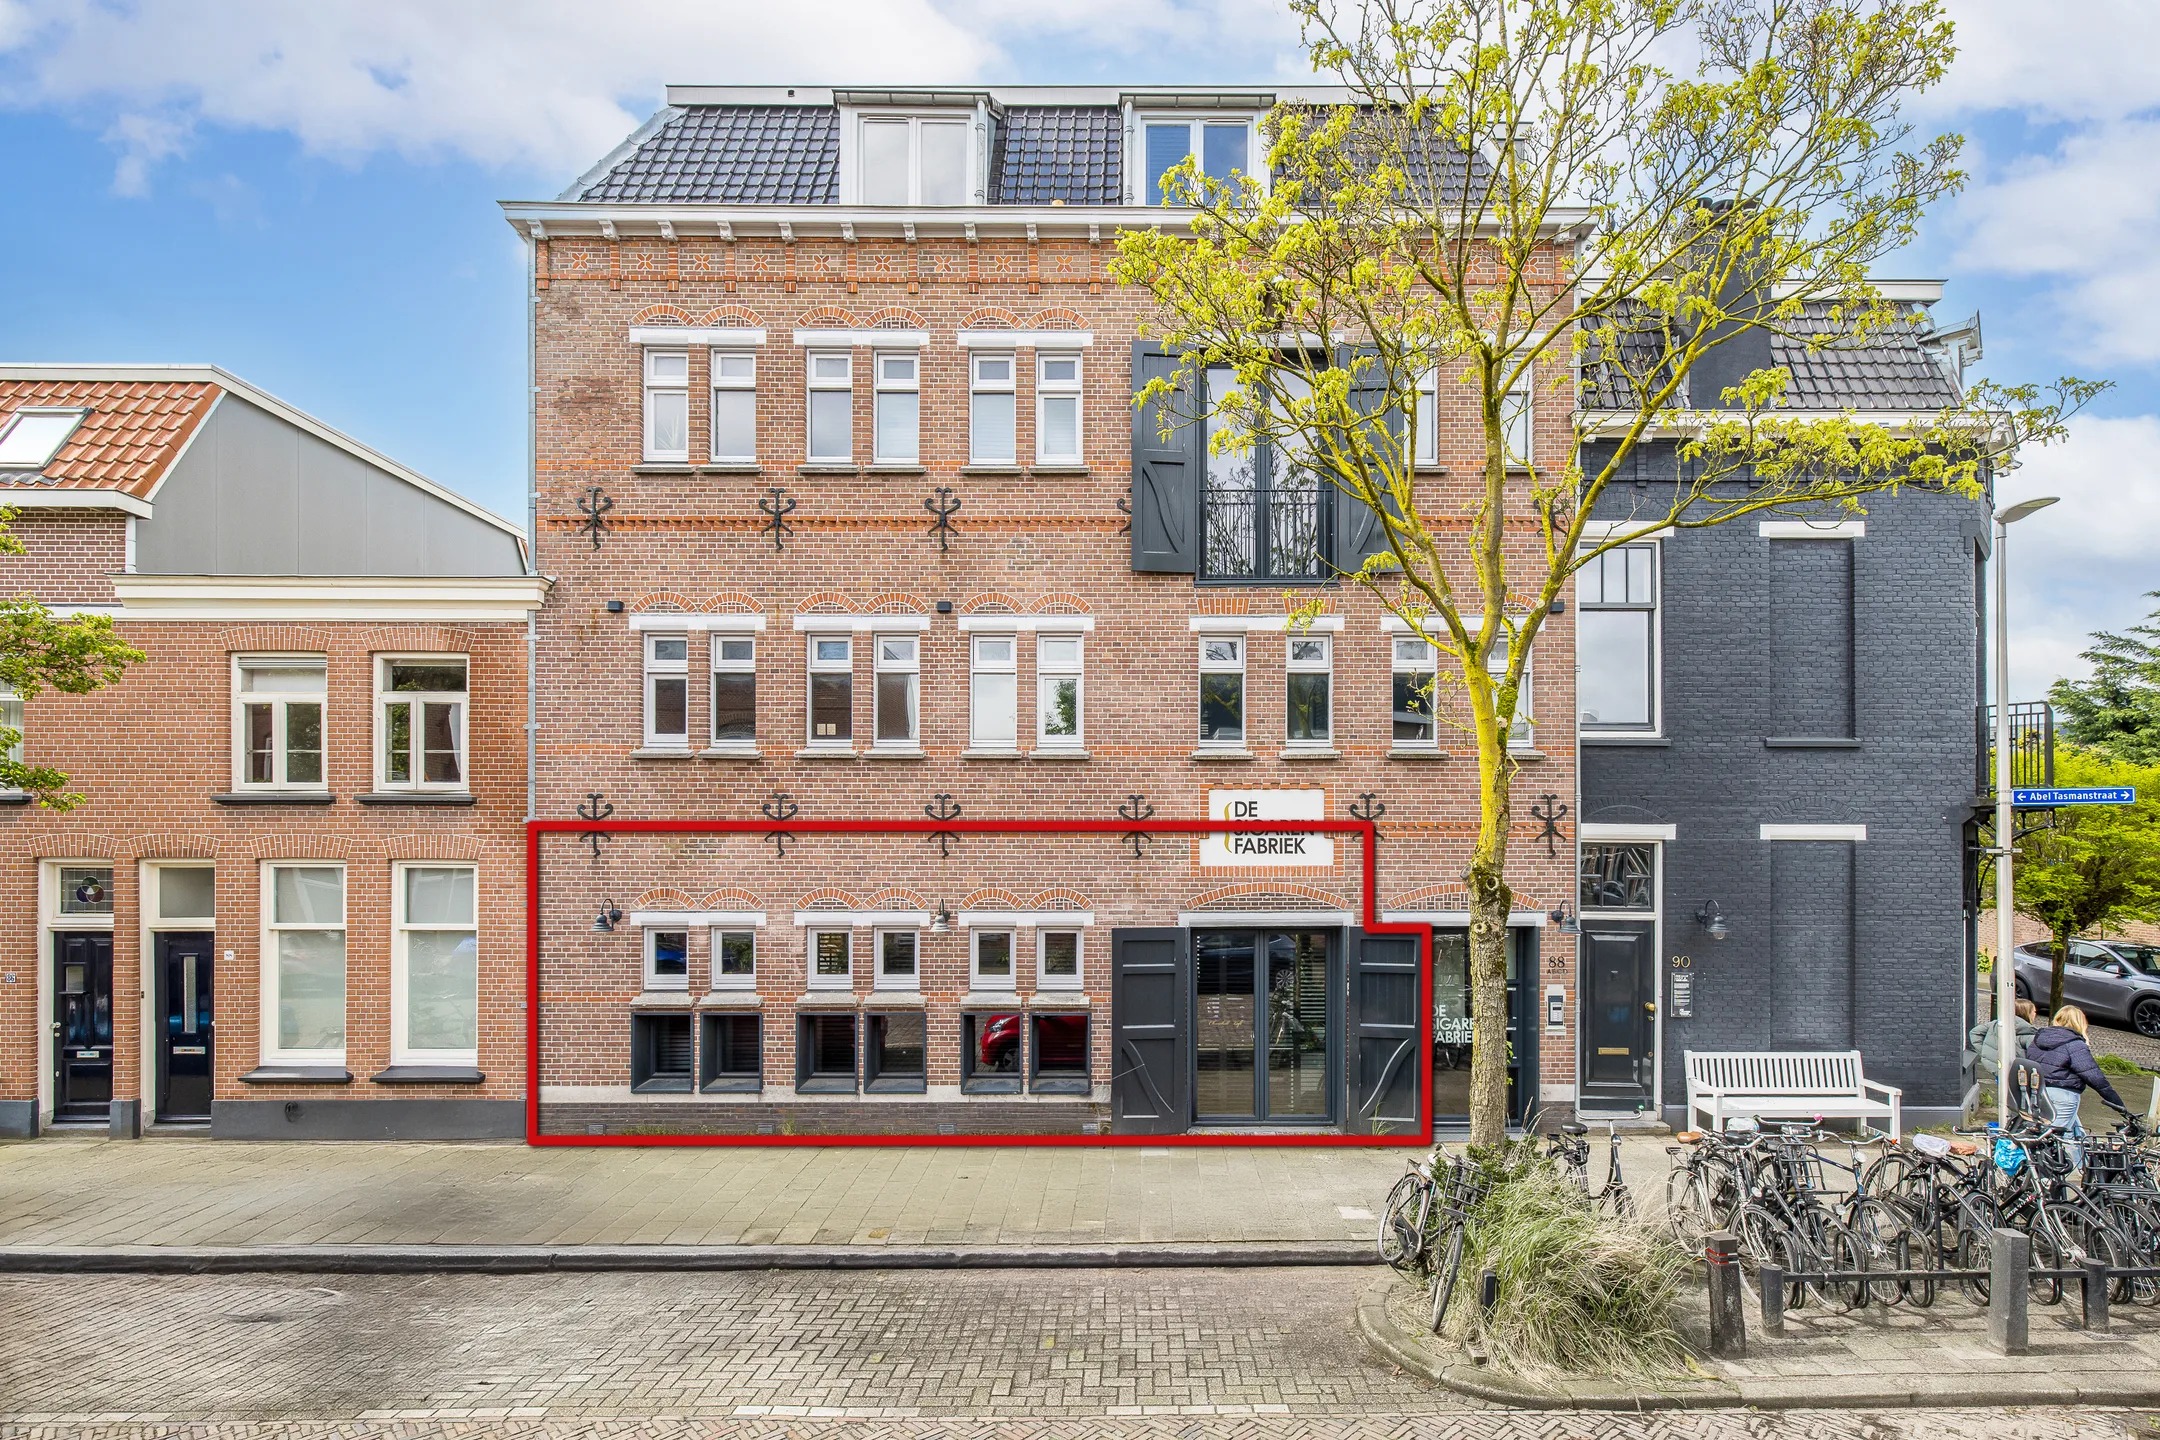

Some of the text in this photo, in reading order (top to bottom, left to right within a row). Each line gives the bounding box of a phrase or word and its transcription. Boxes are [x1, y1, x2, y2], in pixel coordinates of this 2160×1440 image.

[2029, 791, 2117, 801] Abel Tasmanstraat
[1234, 801, 1258, 818] DE
[1234, 838, 1306, 854] FABRIEK
[1548, 955, 1565, 968] 88
[1672, 955, 1690, 968] 90
[1432, 1017, 1474, 1030] IGARE
[1432, 1030, 1474, 1043] ABRIE
